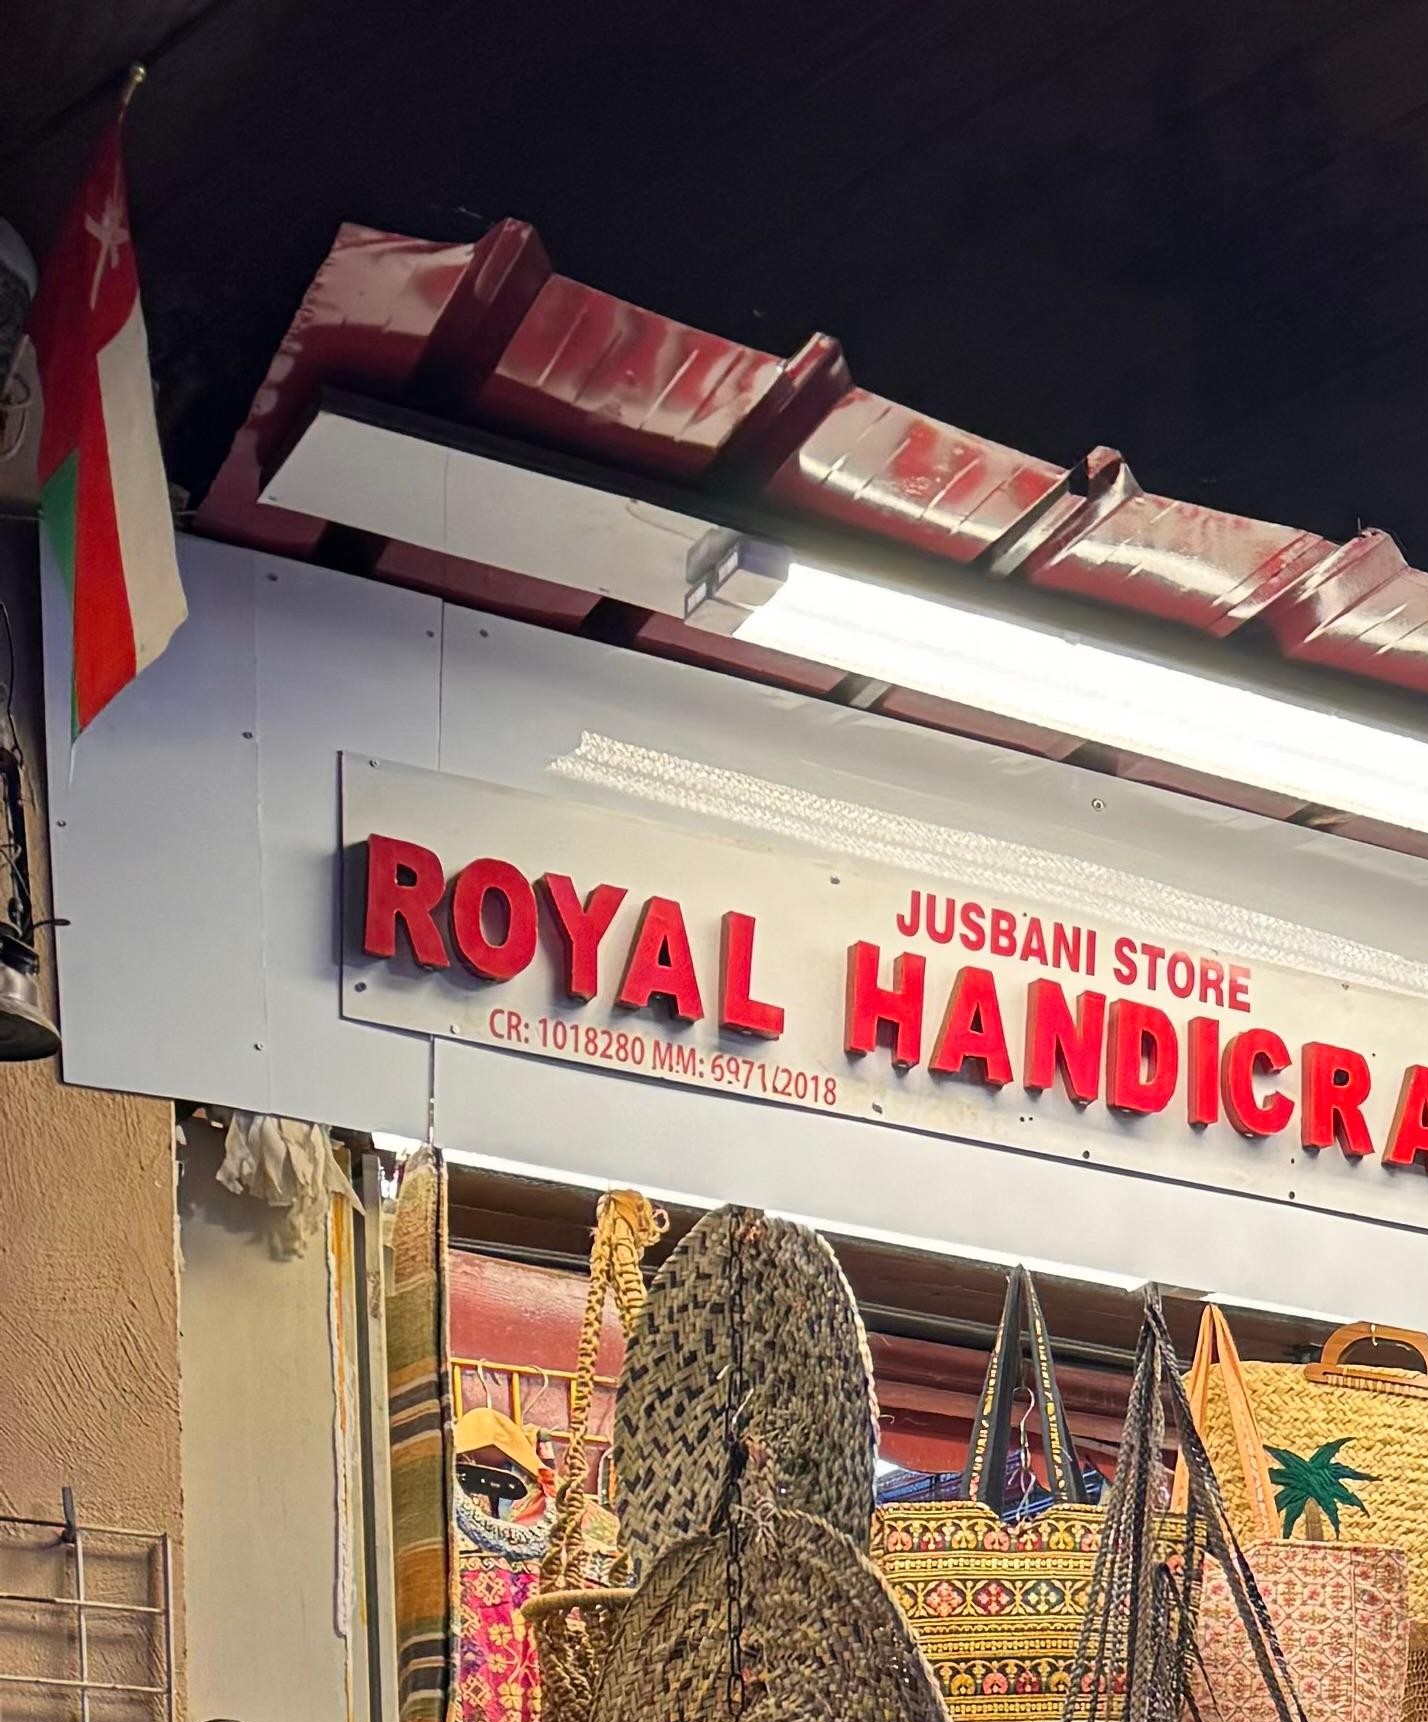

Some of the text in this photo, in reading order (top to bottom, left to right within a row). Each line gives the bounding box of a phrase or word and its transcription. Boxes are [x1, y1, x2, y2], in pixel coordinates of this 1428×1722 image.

[364, 833, 785, 1040] ROYAL
[898, 890, 1252, 1014] JUSBANI STORE
[488, 1008, 530, 1044] CR:
[537, 1018, 646, 1065] 1018280
[651, 1039, 705, 1078] MM:
